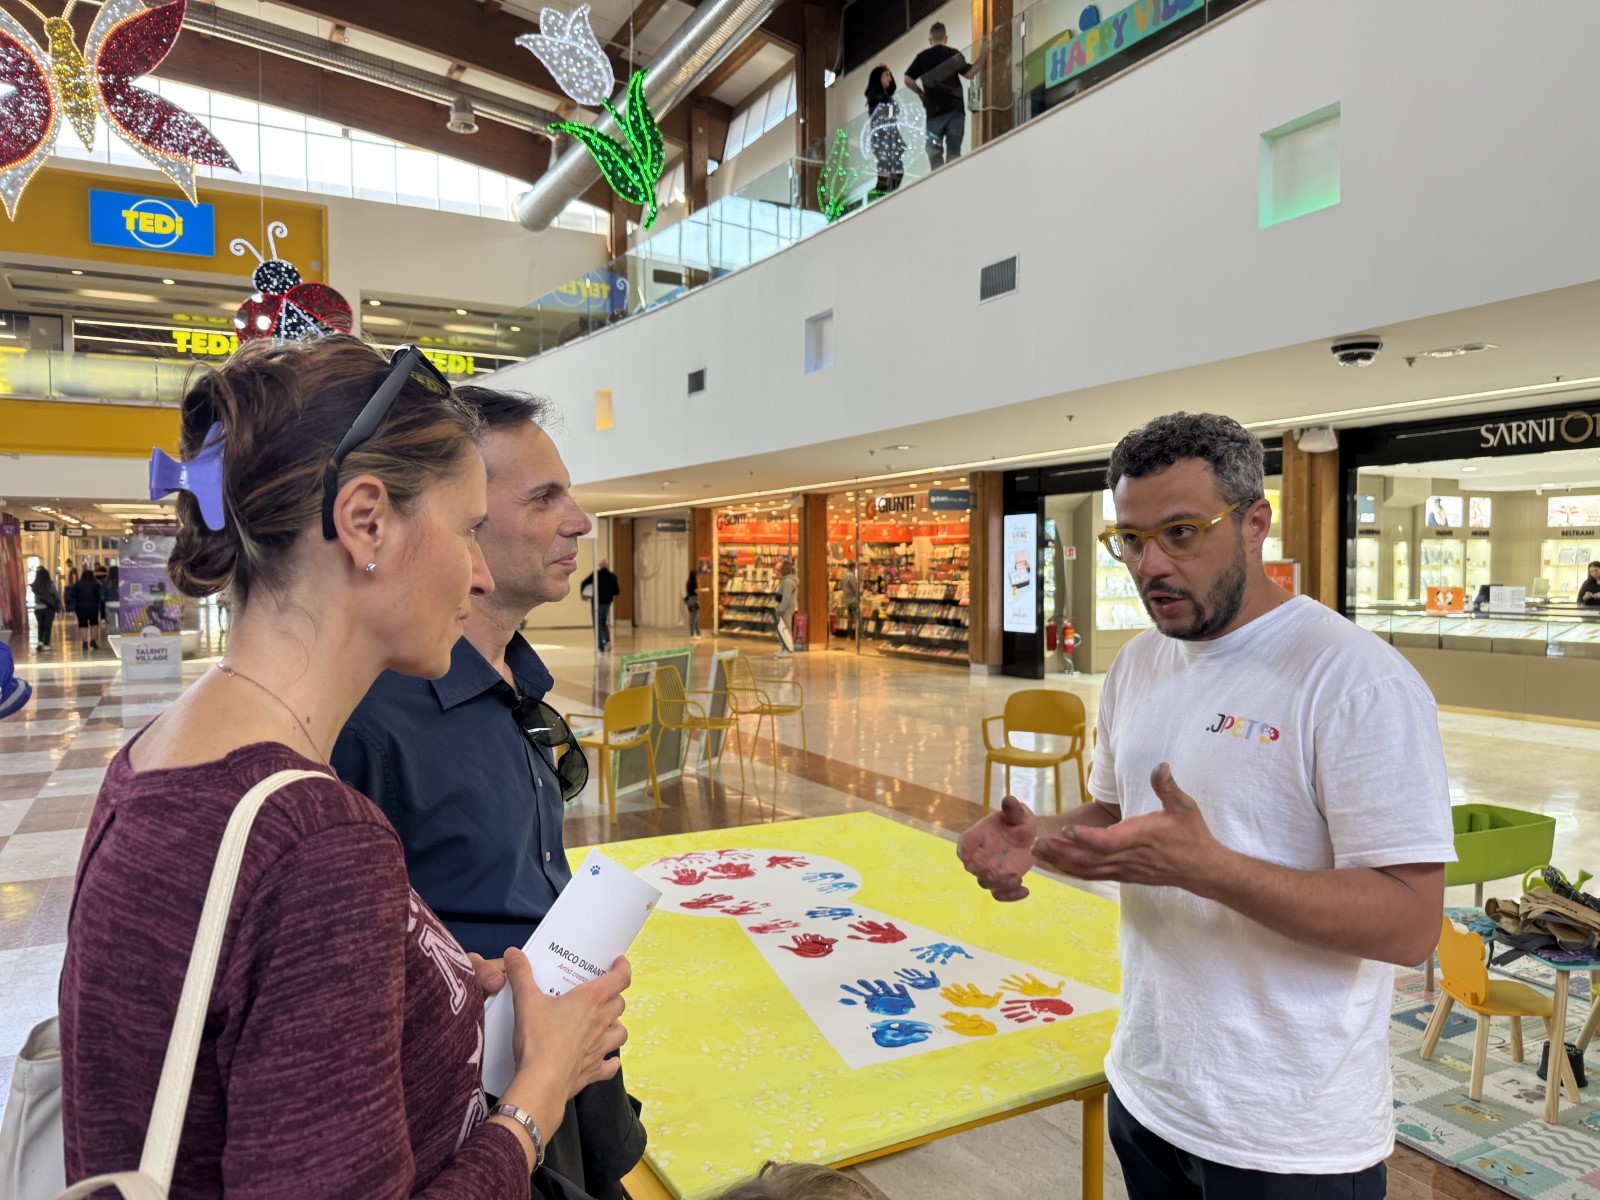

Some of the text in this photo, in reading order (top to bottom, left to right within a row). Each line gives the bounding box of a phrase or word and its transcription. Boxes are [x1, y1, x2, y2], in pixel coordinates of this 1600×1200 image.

[1050, 13, 1127, 81] HAPPY
[122, 210, 183, 236] TEDi
[1480, 411, 1600, 448] SARNI O
[548, 942, 607, 977] MARCO DURANT
[557, 963, 572, 975] Artist
